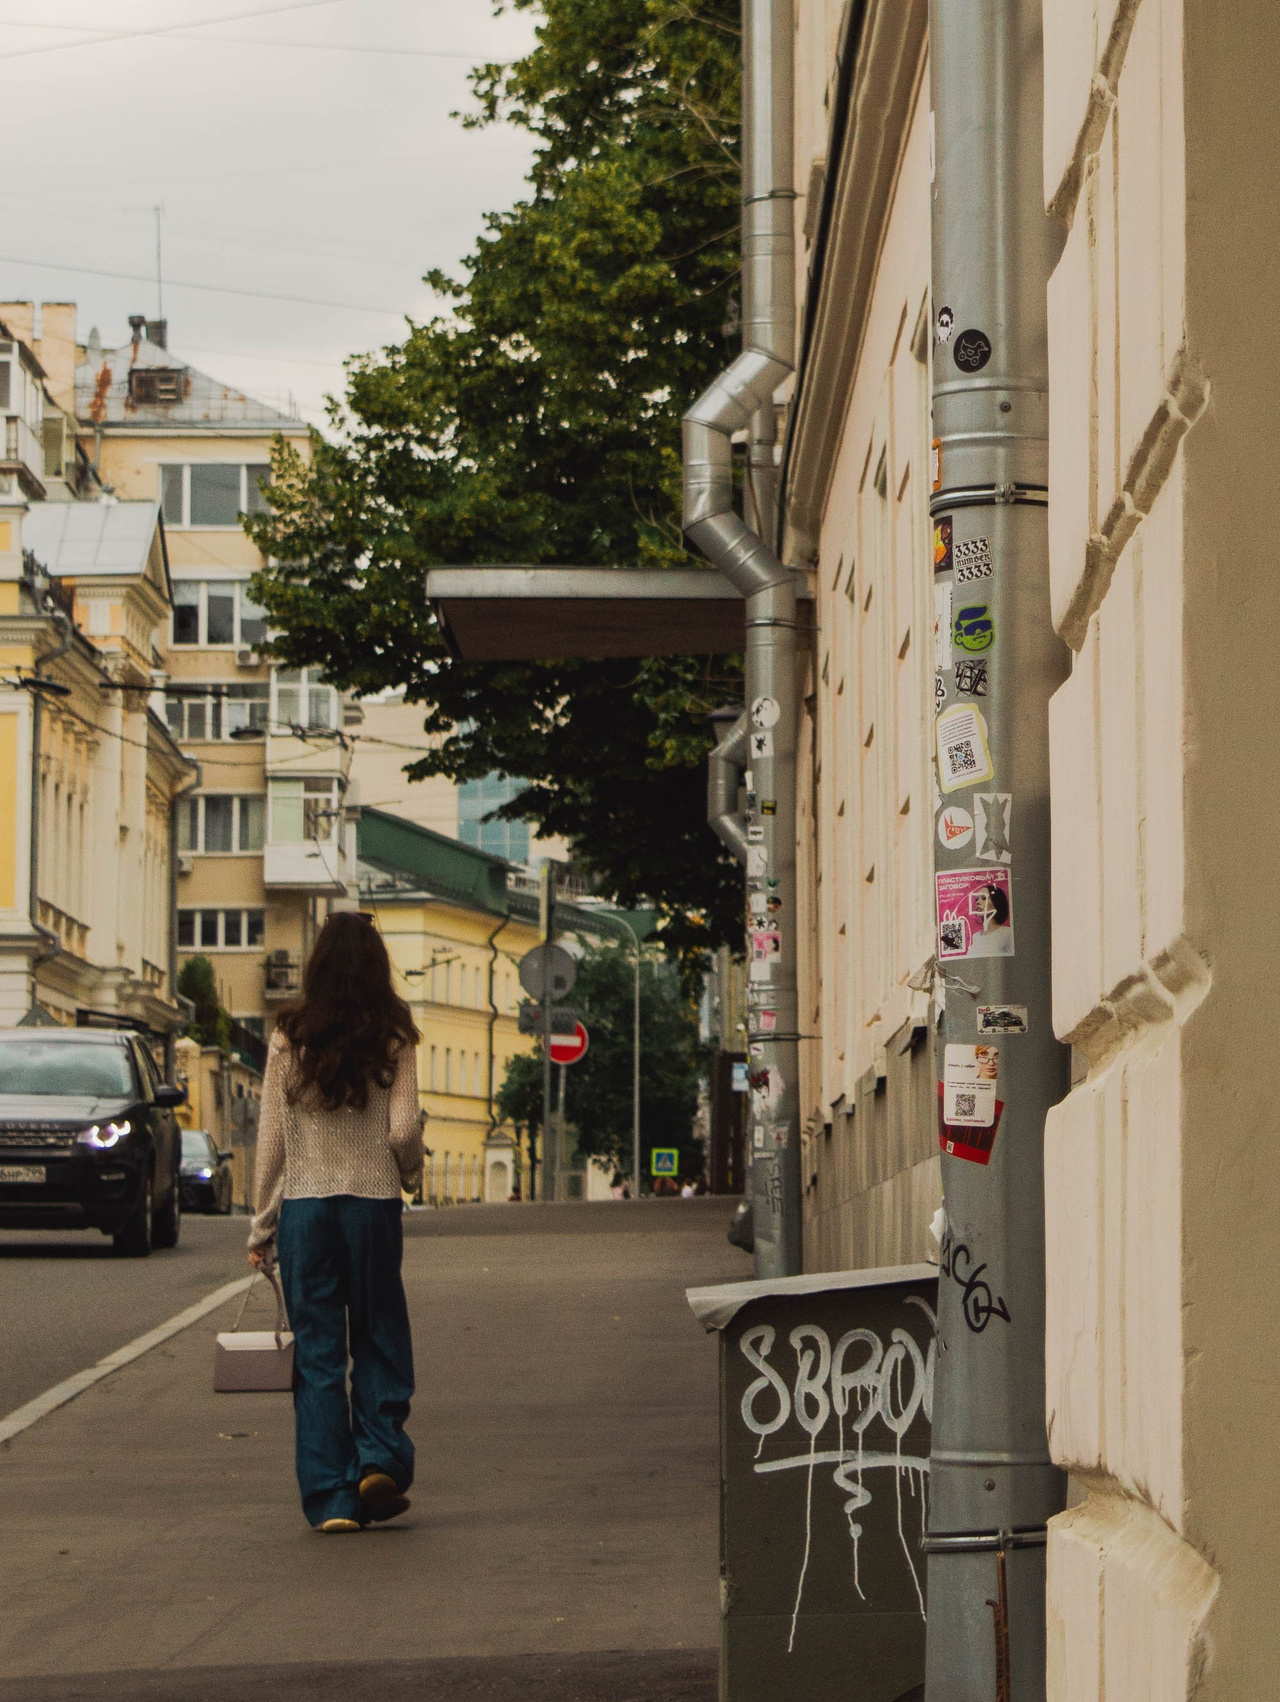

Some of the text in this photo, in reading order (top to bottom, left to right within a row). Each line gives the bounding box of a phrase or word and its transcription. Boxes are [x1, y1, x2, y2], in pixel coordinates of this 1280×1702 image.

[955, 539, 988, 558] 3333
[958, 563, 992, 582] 3333
[0, 1122, 59, 1130] OVERY
